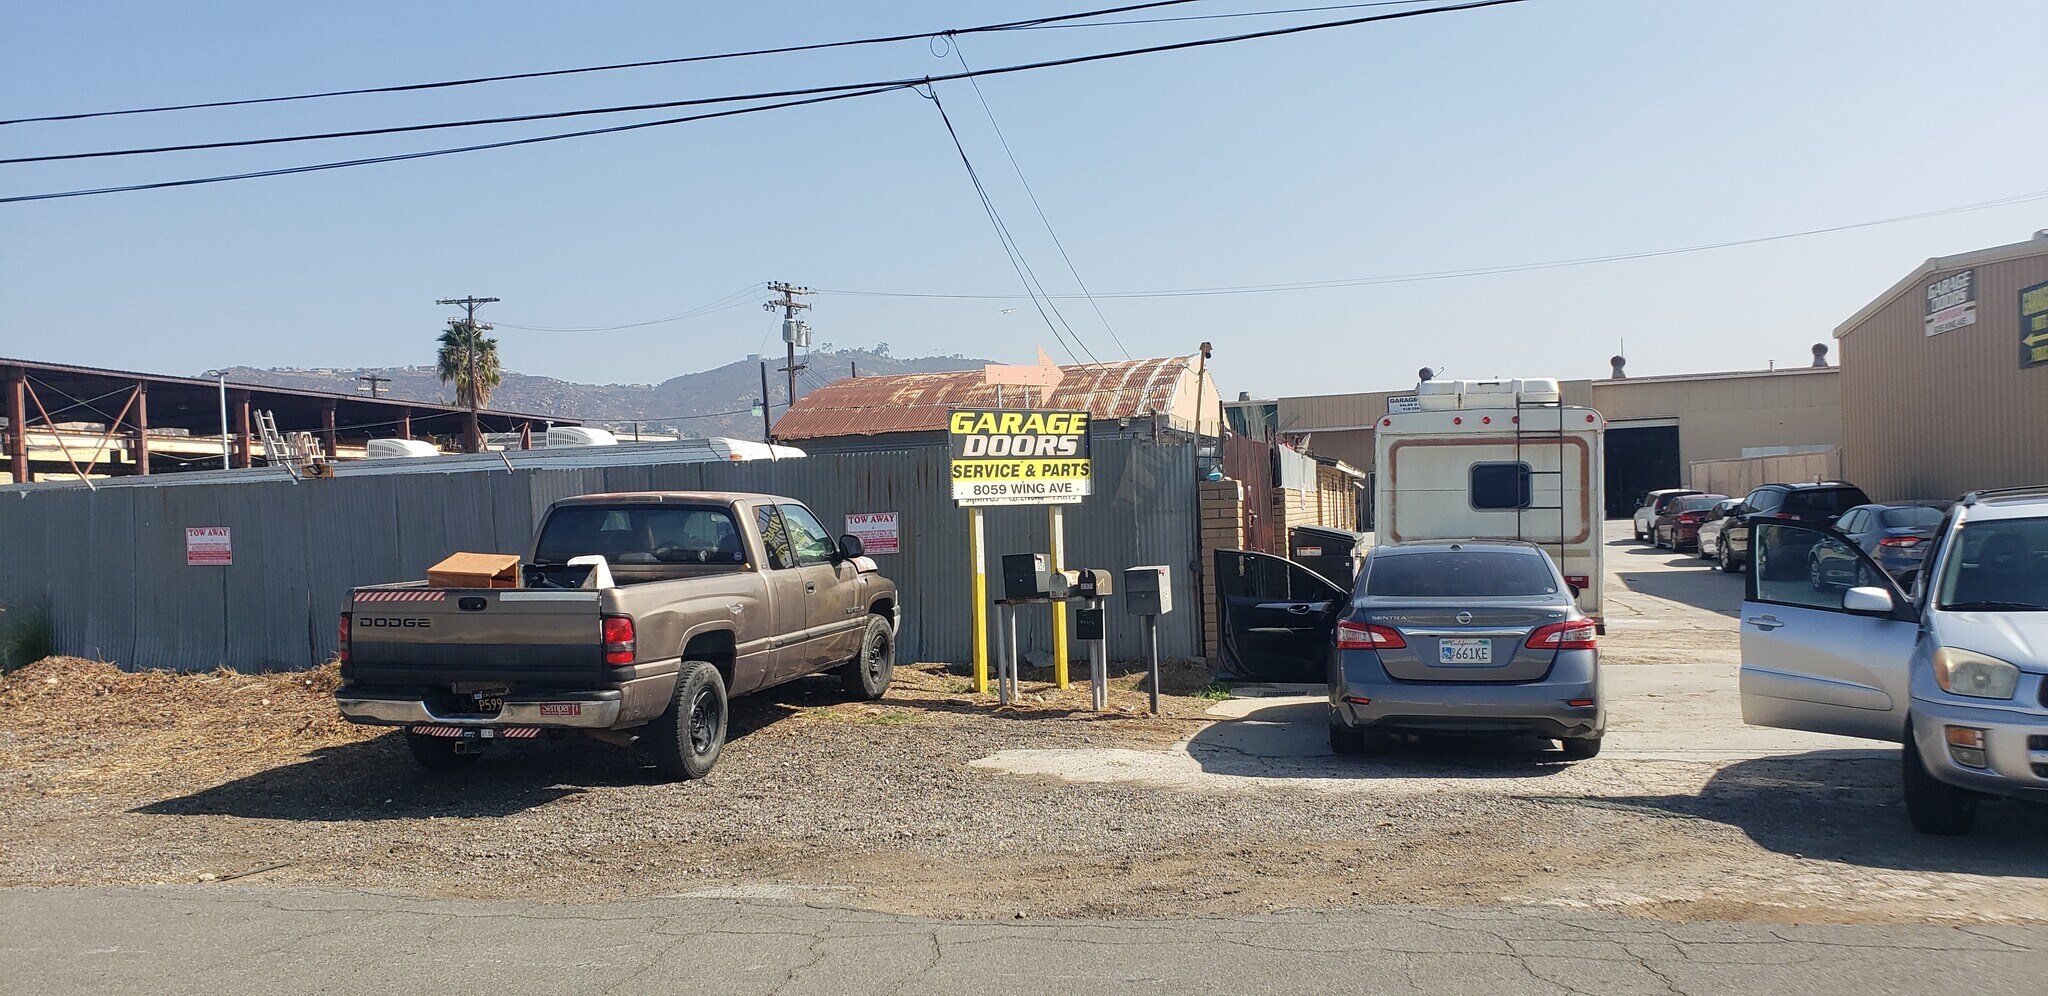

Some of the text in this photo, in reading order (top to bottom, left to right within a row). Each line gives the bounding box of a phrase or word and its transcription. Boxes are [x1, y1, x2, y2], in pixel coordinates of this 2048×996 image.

[950, 412, 1088, 434] GARAGE
[962, 435, 1078, 456] DOORS
[952, 463, 1090, 479] SERVICE & PARTS
[973, 482, 1072, 495] 8059 WING AVE
[848, 514, 895, 524] TOW AWAY
[207, 528, 227, 536] AWAY
[359, 617, 431, 628] DODGE
[1455, 647, 1488, 660] 661KE
[478, 698, 503, 712] P599
